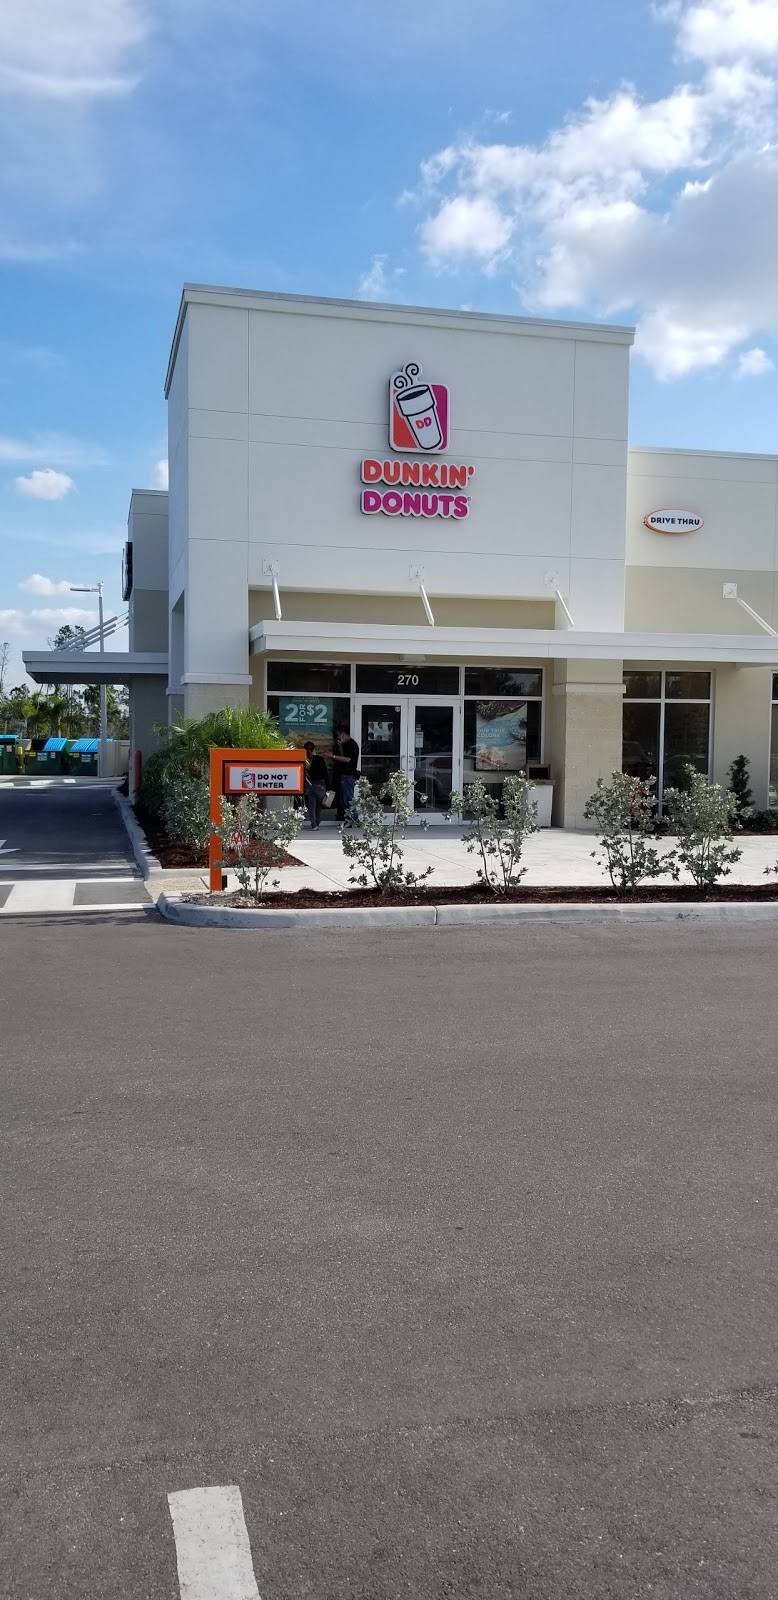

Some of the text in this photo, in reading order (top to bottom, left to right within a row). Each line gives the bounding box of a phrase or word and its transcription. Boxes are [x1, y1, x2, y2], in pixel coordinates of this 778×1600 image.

[415, 416, 432, 429] DD
[363, 459, 475, 488] DUNKIN'
[363, 490, 469, 518] DONUTS
[650, 516, 700, 526] DRIVE THRU
[397, 674, 420, 686] 270
[284, 703, 299, 722] 2
[306, 703, 328, 723] $2
